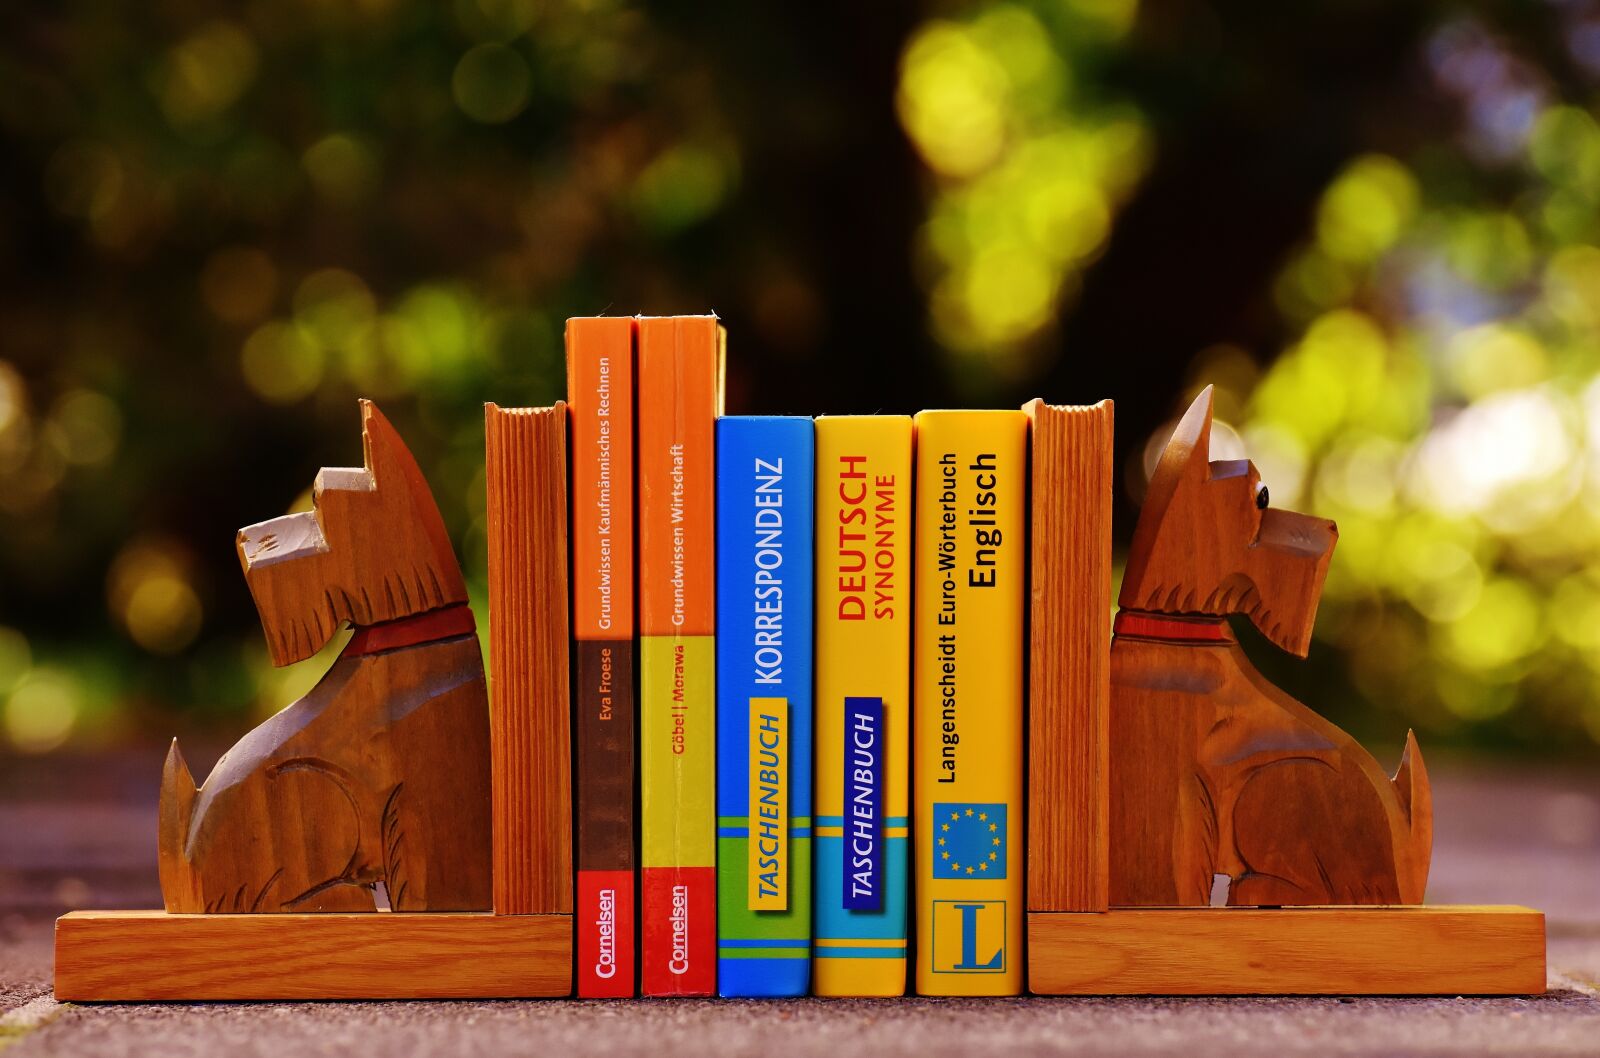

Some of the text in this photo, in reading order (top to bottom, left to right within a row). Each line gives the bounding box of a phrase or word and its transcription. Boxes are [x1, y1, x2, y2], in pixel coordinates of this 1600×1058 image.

[596, 357, 612, 630] Grundwissen Kaufmännisches Rechnen
[669, 443, 685, 626] Grundwissen Wirtschaft
[838, 456, 867, 621] DEUTSCH
[874, 474, 895, 620] SYNONYME
[968, 453, 1002, 587] Englisch
[754, 457, 783, 684] KORRESPONDENZ
[938, 453, 960, 784] Langenscheidt Euro-Wörterbuch
[599, 648, 612, 721] Eva Froese
[672, 645, 685, 703] Morawa
[672, 714, 685, 755] Göbel
[758, 713, 780, 899] TASCHENBUCH
[852, 712, 875, 899] TASCHENBUCH
[595, 889, 616, 979] Cornelsen
[668, 885, 688, 975] Cornelsen
[953, 904, 1002, 969] L
